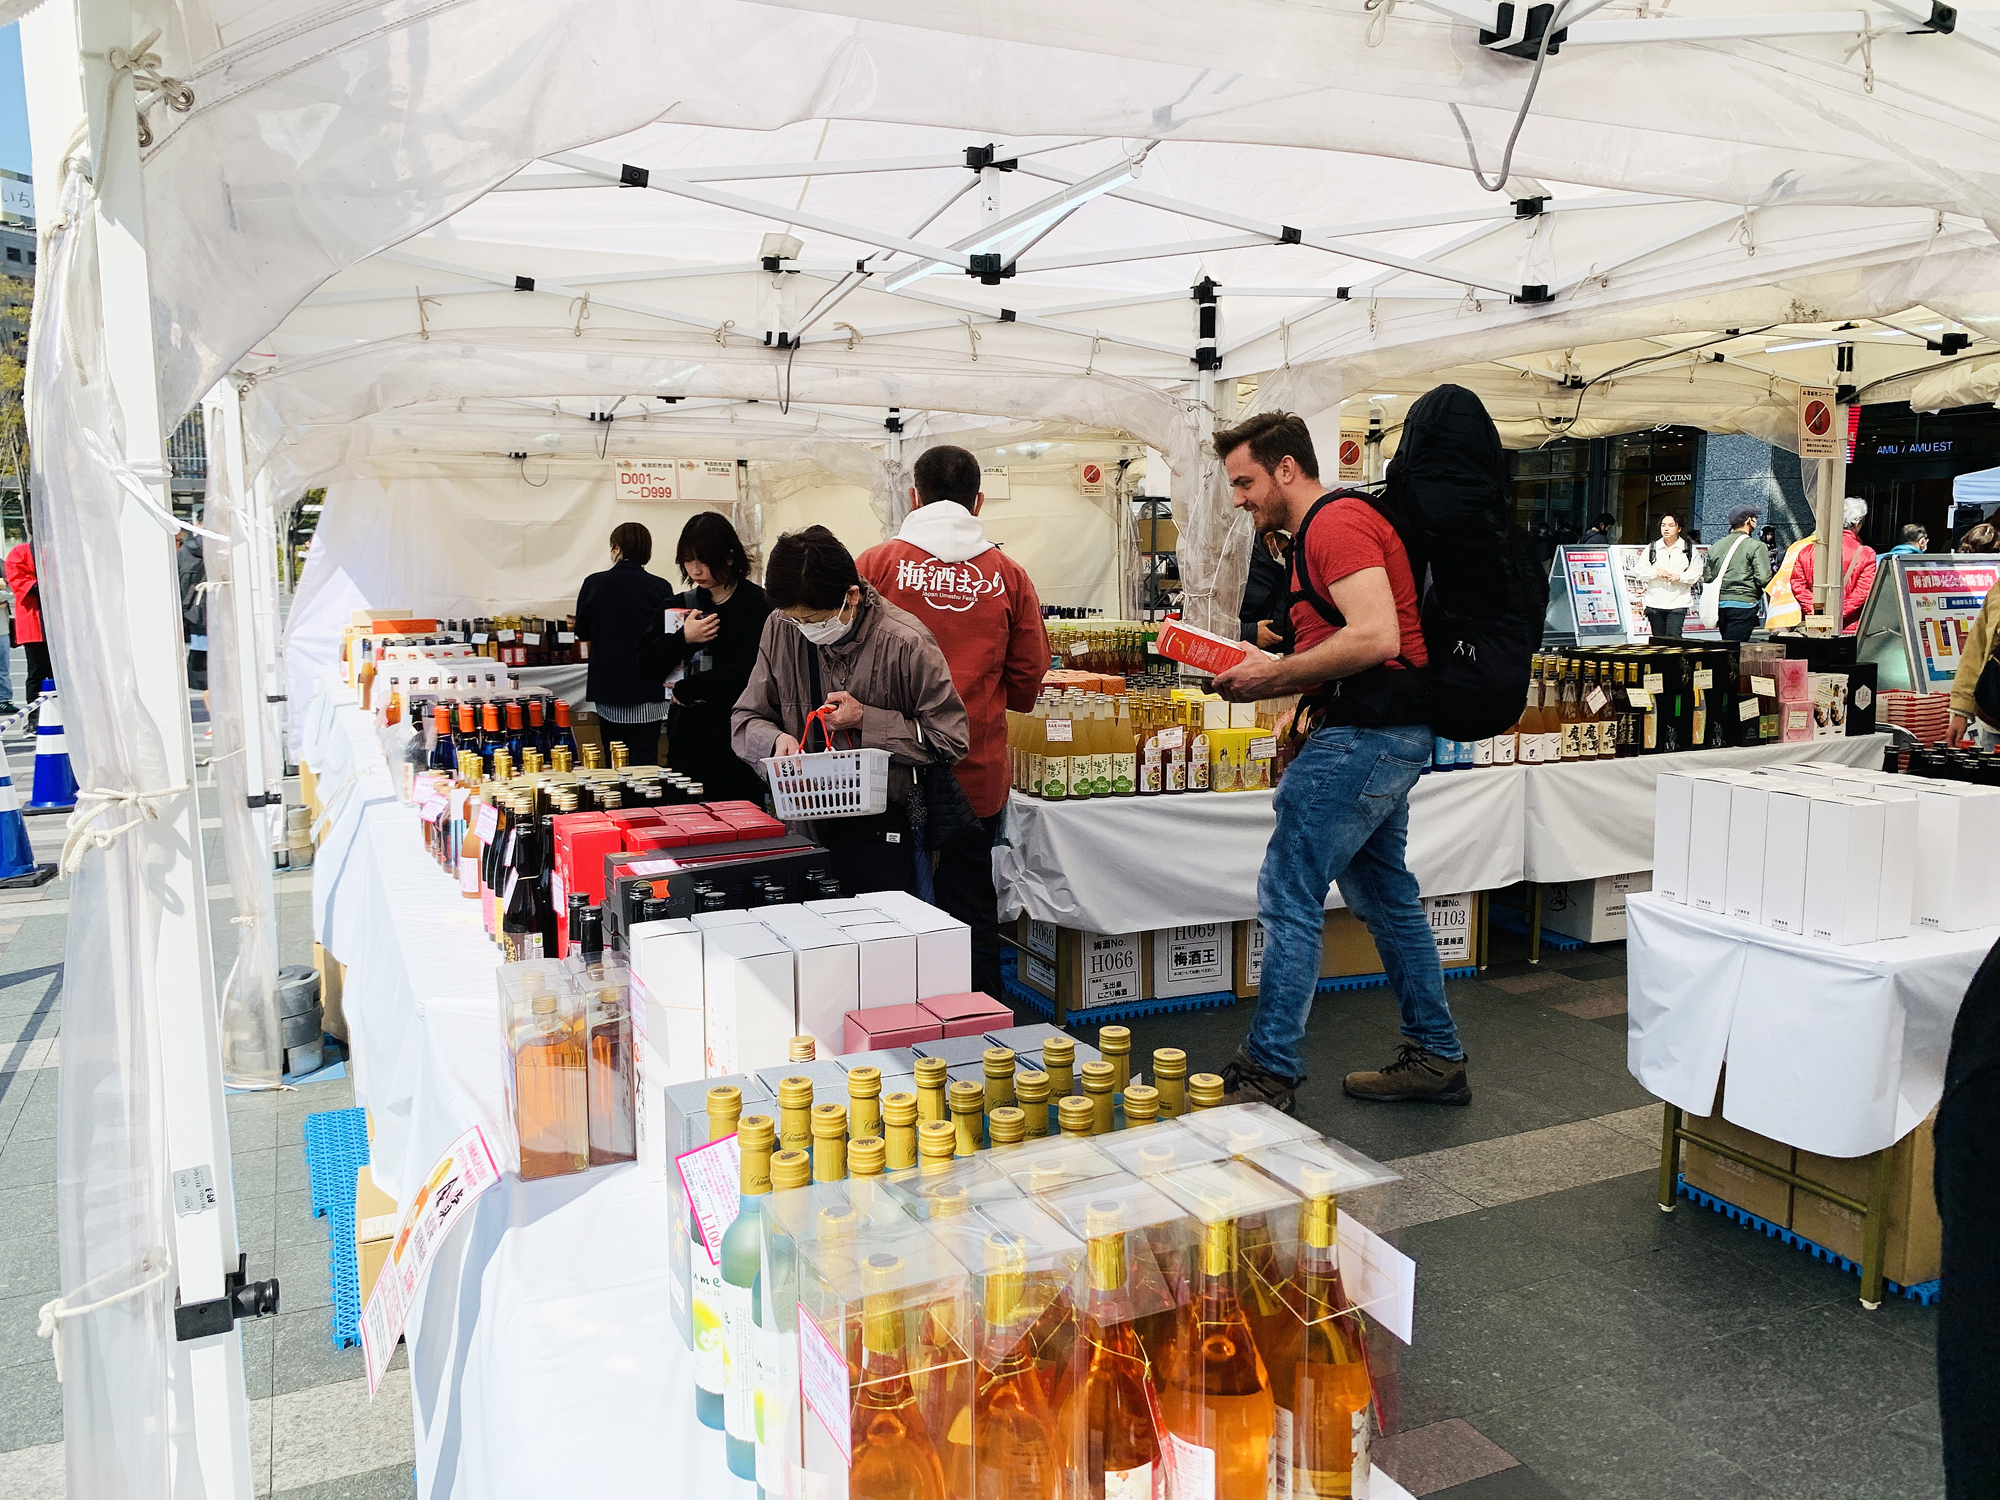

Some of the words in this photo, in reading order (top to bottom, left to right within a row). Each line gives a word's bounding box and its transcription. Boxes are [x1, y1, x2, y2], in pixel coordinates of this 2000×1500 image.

[2, 187, 34, 208] いち
[1877, 445, 1898, 455] AMU
[1909, 443, 1932, 453] AMU
[1933, 441, 1953, 451] EST
[895, 559, 1006, 598] 梅酒まつり
[1913, 574, 1994, 589] 梅酒即売会会場案内
[922, 590, 938, 599] Japan
[1431, 909, 1465, 926] H103
[1032, 920, 1055, 947] H066
[1174, 923, 1215, 941] H069
[1253, 931, 1265, 949] H
[1093, 939, 1127, 951] 梅酒No.
[1091, 949, 1133, 975] H066
[1173, 949, 1216, 967] 梅酒王
[1102, 980, 1122, 991] 玉出泉
[691, 1192, 704, 1213] 500ml
[699, 1211, 723, 1250] 1,100
[712, 1250, 721, 1260] 円
